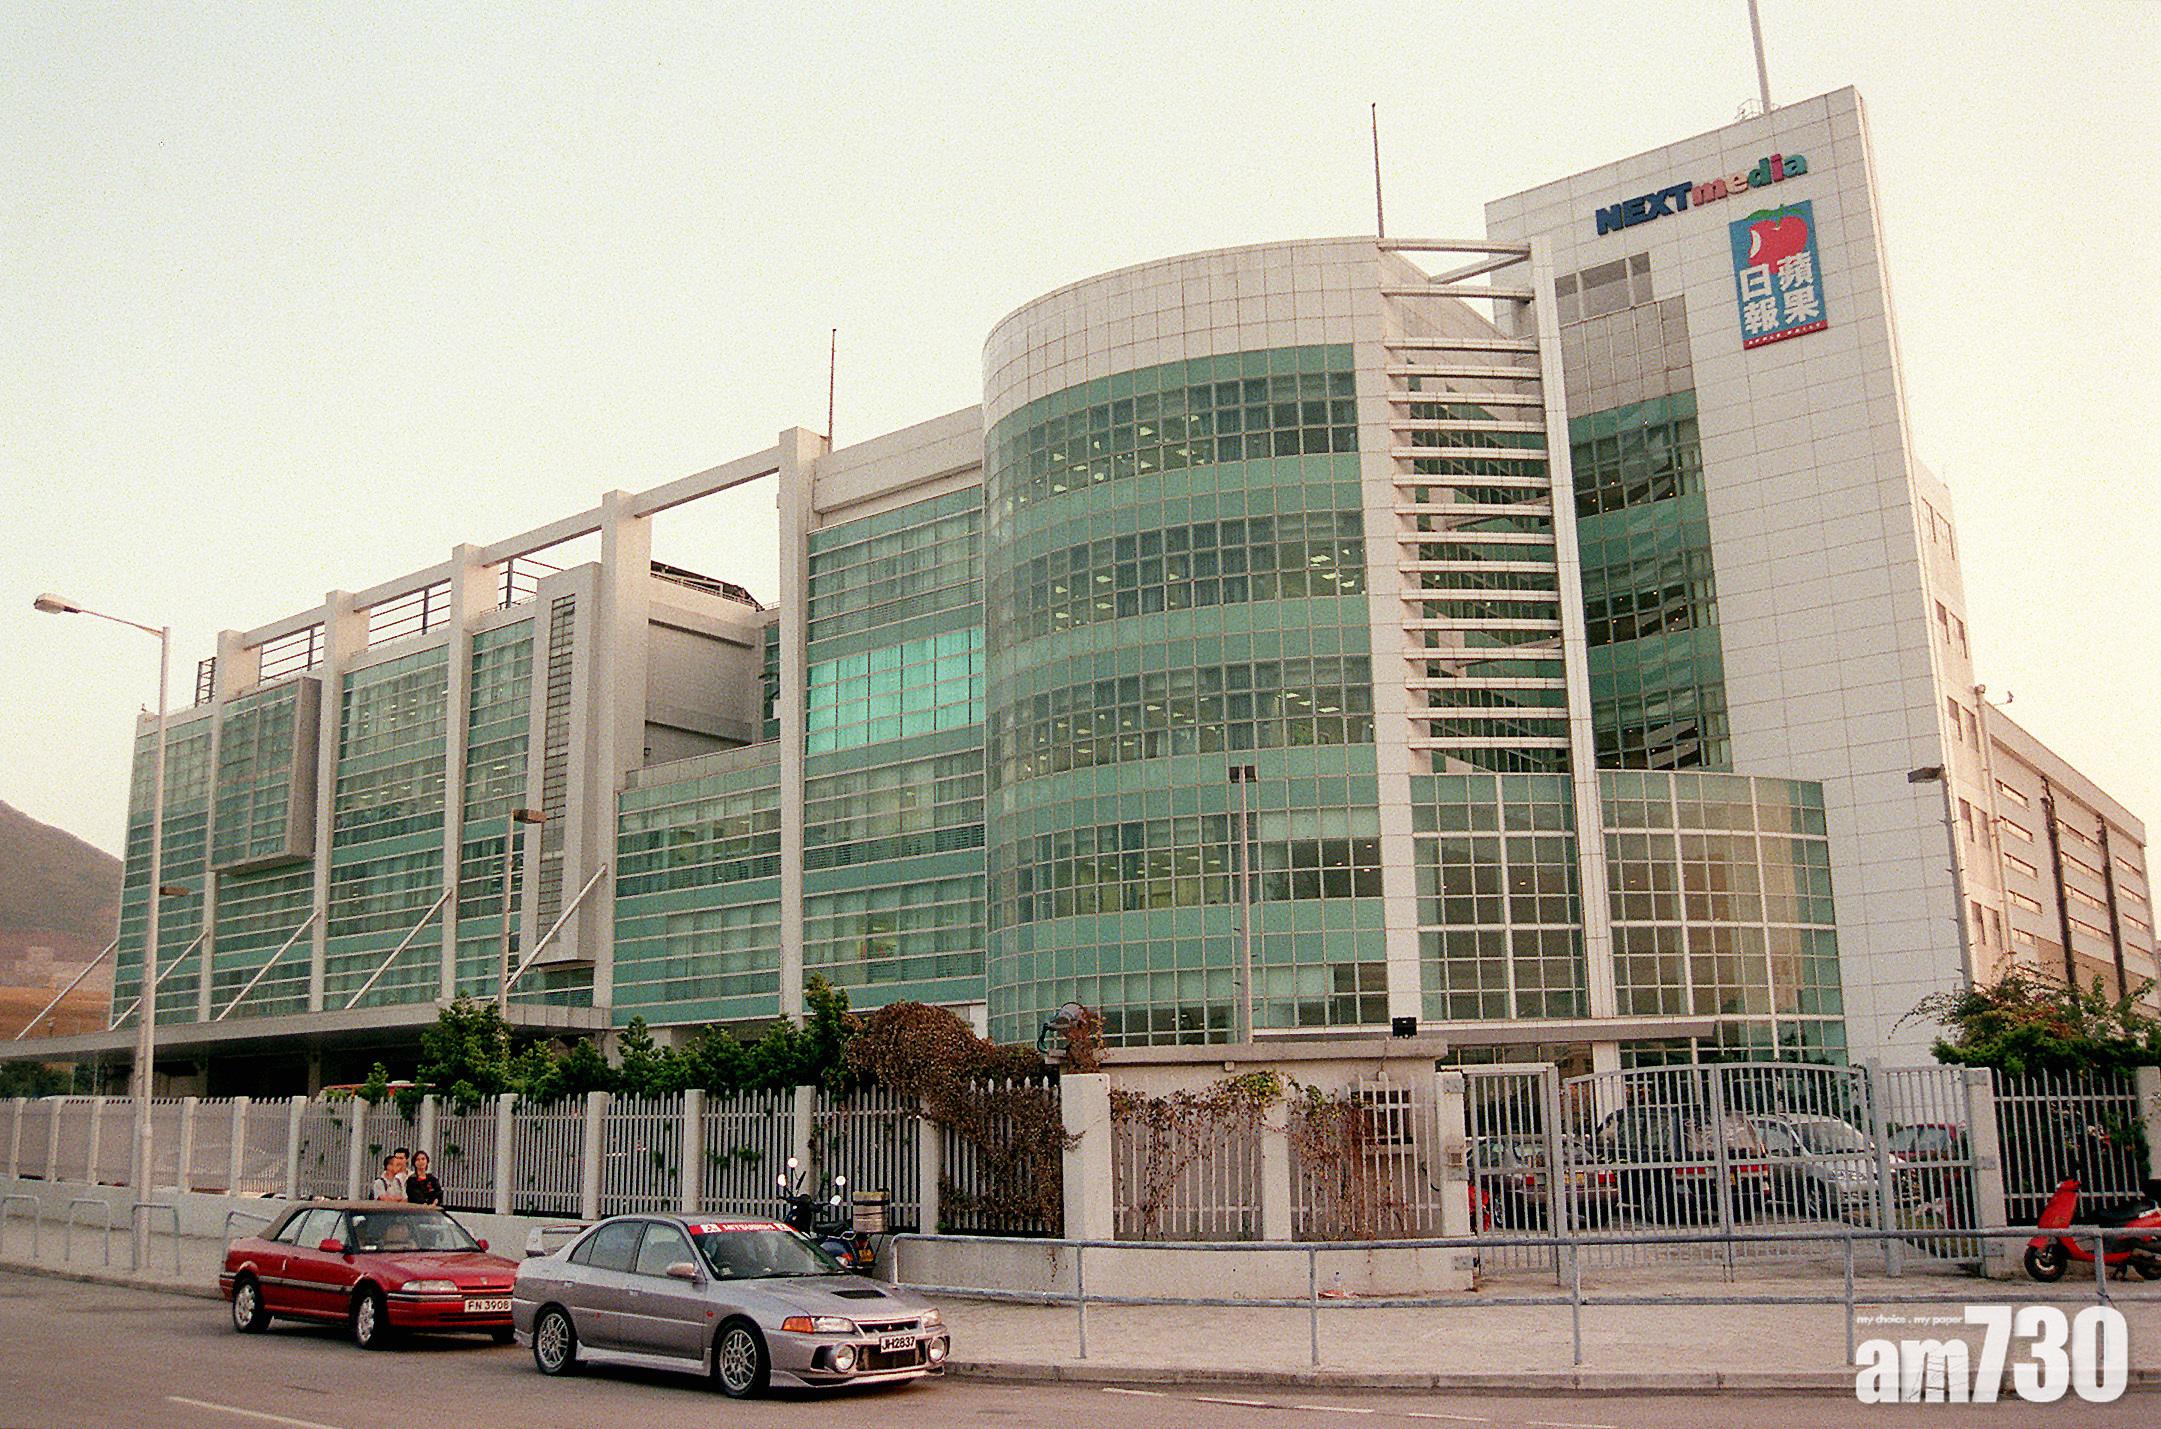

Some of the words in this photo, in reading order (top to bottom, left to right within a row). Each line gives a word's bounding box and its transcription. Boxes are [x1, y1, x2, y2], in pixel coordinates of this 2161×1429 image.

[1595, 153, 1807, 235] NEXTmedia
[1740, 263, 1780, 334] 日報
[484, 1300, 509, 1310] 3908
